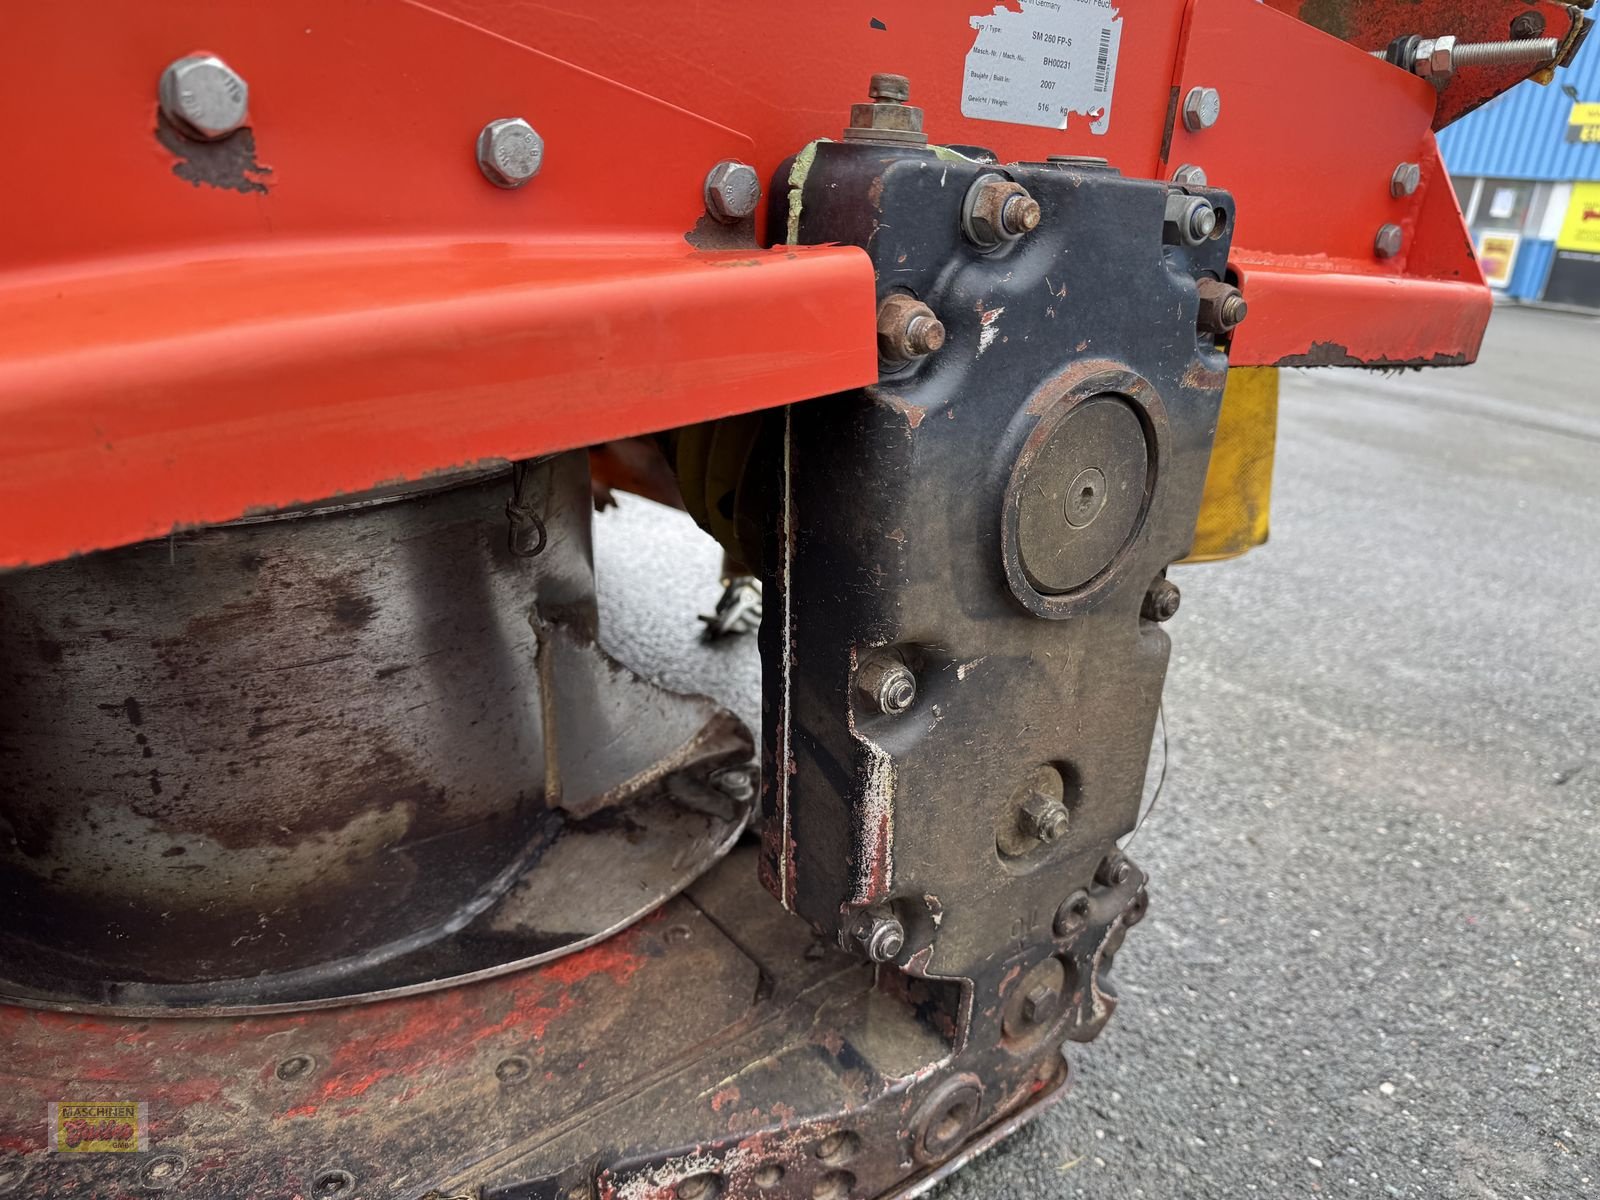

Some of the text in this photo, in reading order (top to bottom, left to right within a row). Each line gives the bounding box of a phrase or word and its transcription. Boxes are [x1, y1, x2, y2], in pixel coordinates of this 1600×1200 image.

[1035, 0, 1061, 12] Germany
[1032, 31, 1073, 47] SM 260 FP-S
[1043, 57, 1071, 69] BH00231
[970, 71, 989, 80] Baujahr
[1040, 80, 1056, 90] 2007
[1037, 103, 1068, 116] 516 kg
